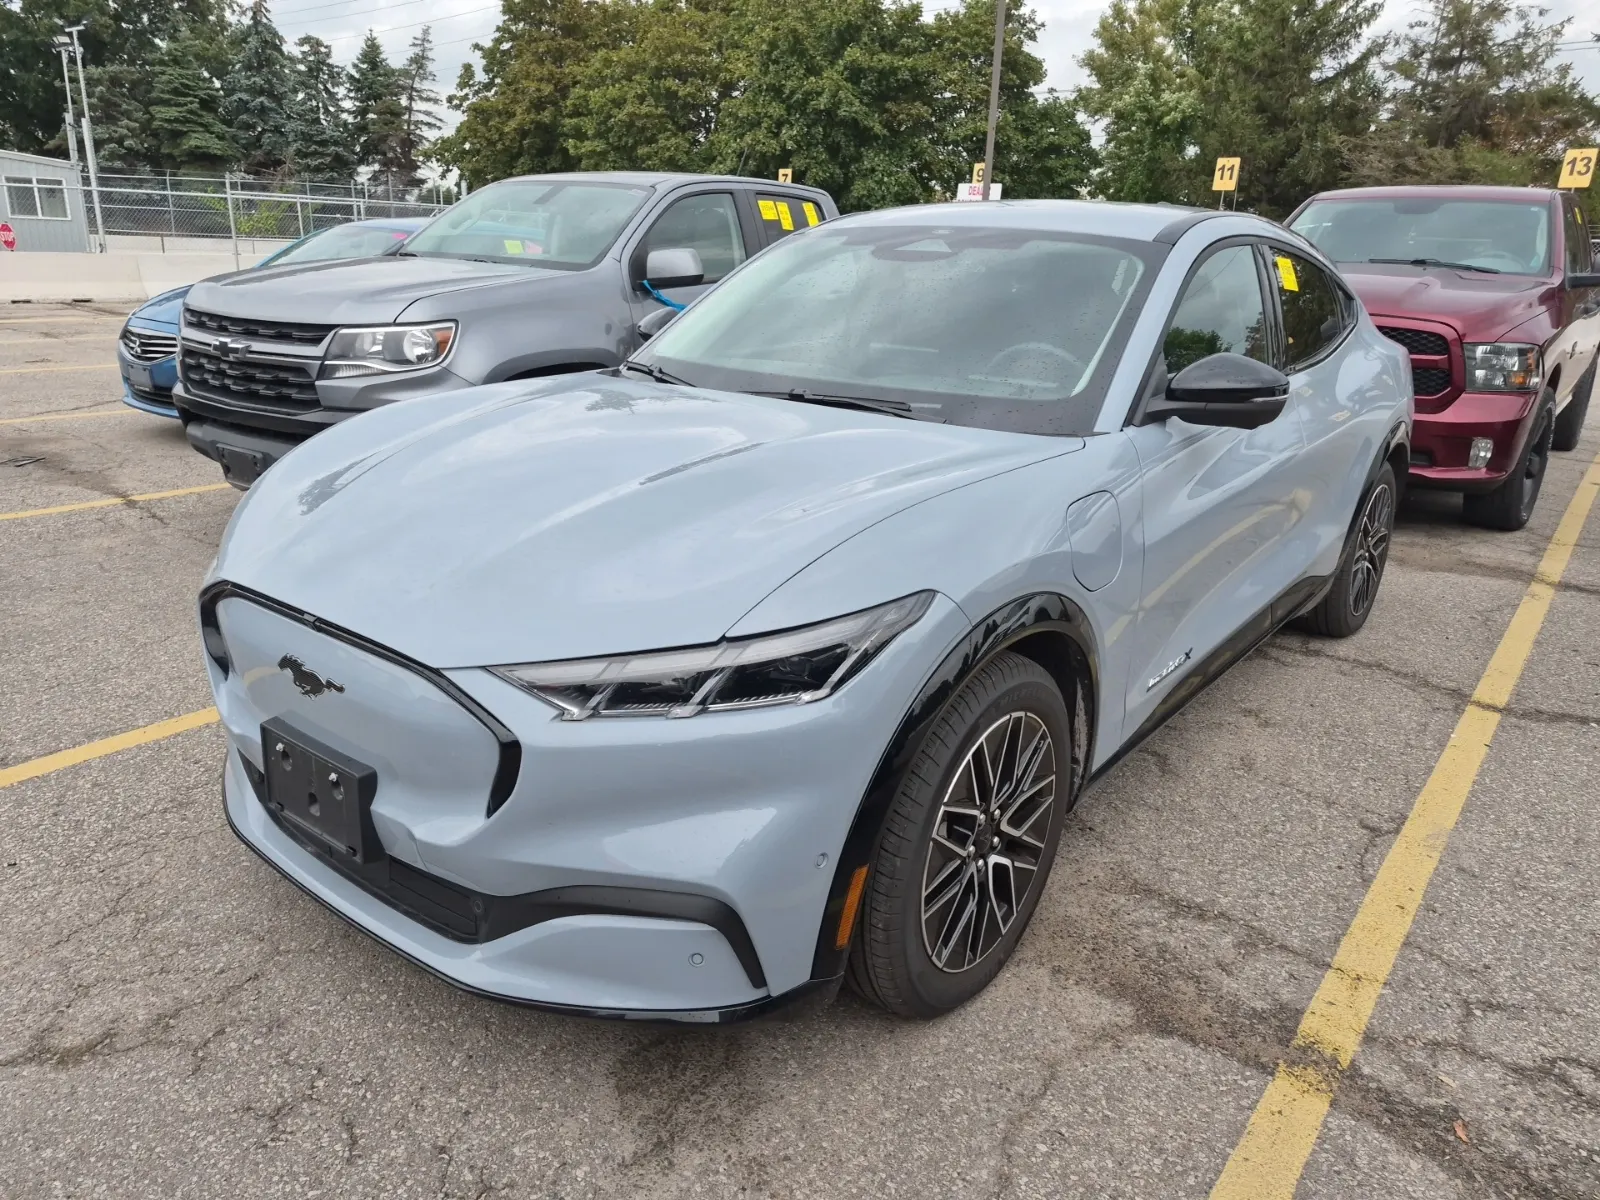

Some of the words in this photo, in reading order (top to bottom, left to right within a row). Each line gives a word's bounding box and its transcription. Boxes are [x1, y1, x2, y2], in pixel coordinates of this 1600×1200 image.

[1217, 164, 1235, 180] 11
[1566, 156, 1592, 176] 13
[782, 173, 789, 182] 7
[0, 231, 14, 242] STOP
